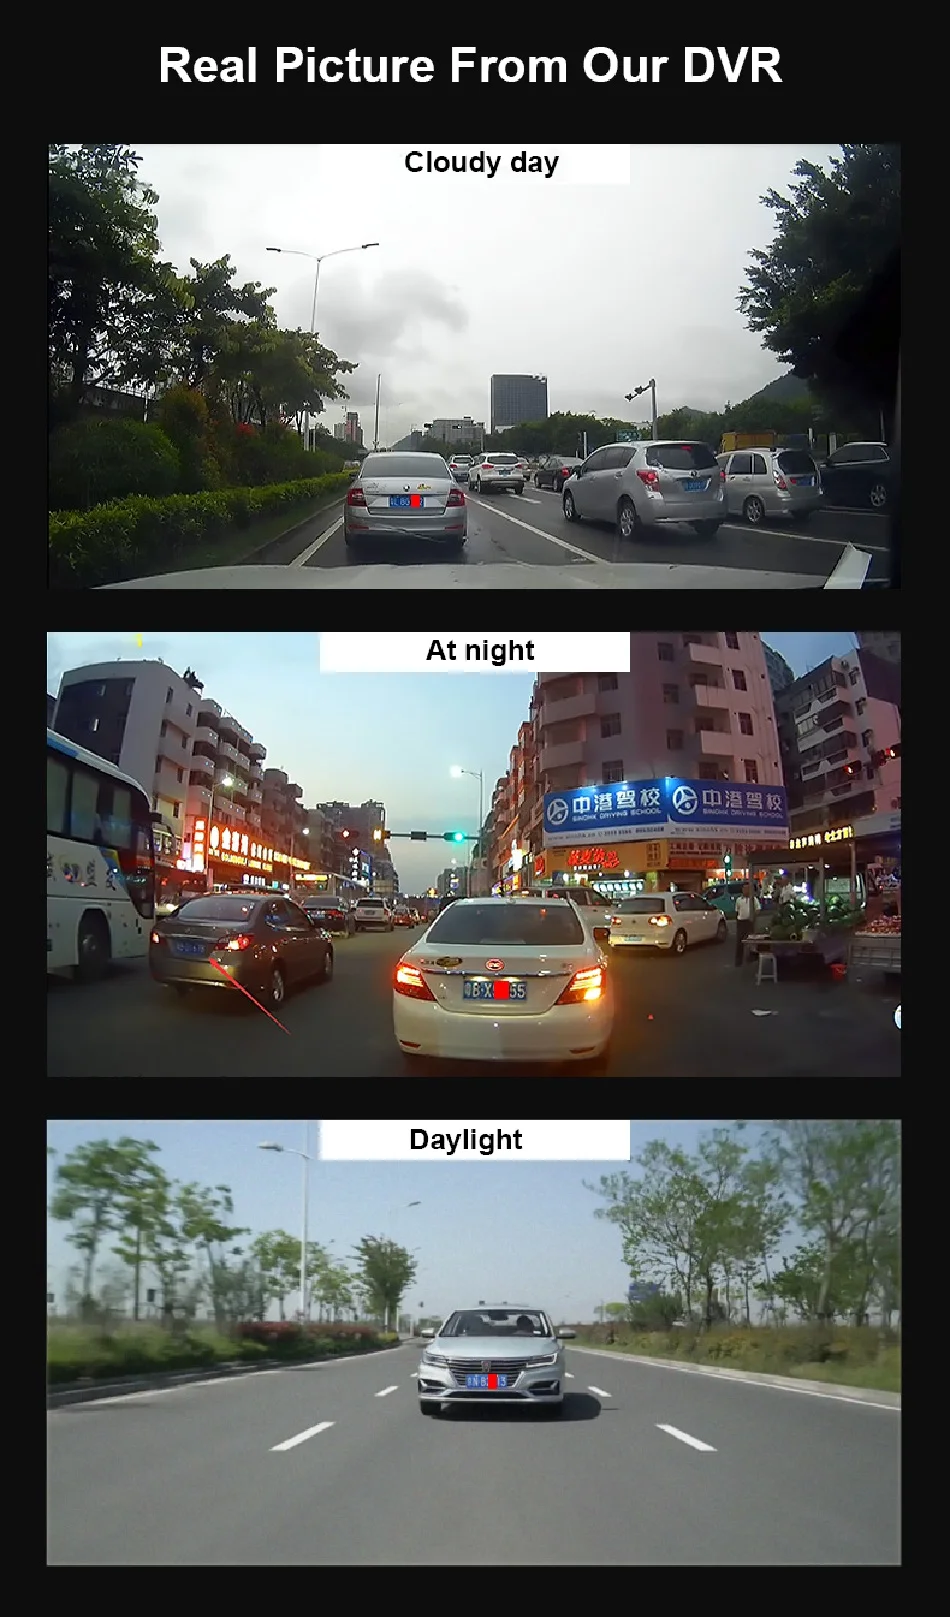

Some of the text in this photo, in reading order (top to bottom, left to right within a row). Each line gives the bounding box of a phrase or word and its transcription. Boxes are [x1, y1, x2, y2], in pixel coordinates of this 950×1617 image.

[573, 788, 660, 814] 中港驾校
[702, 789, 783, 811] 中港驾校
